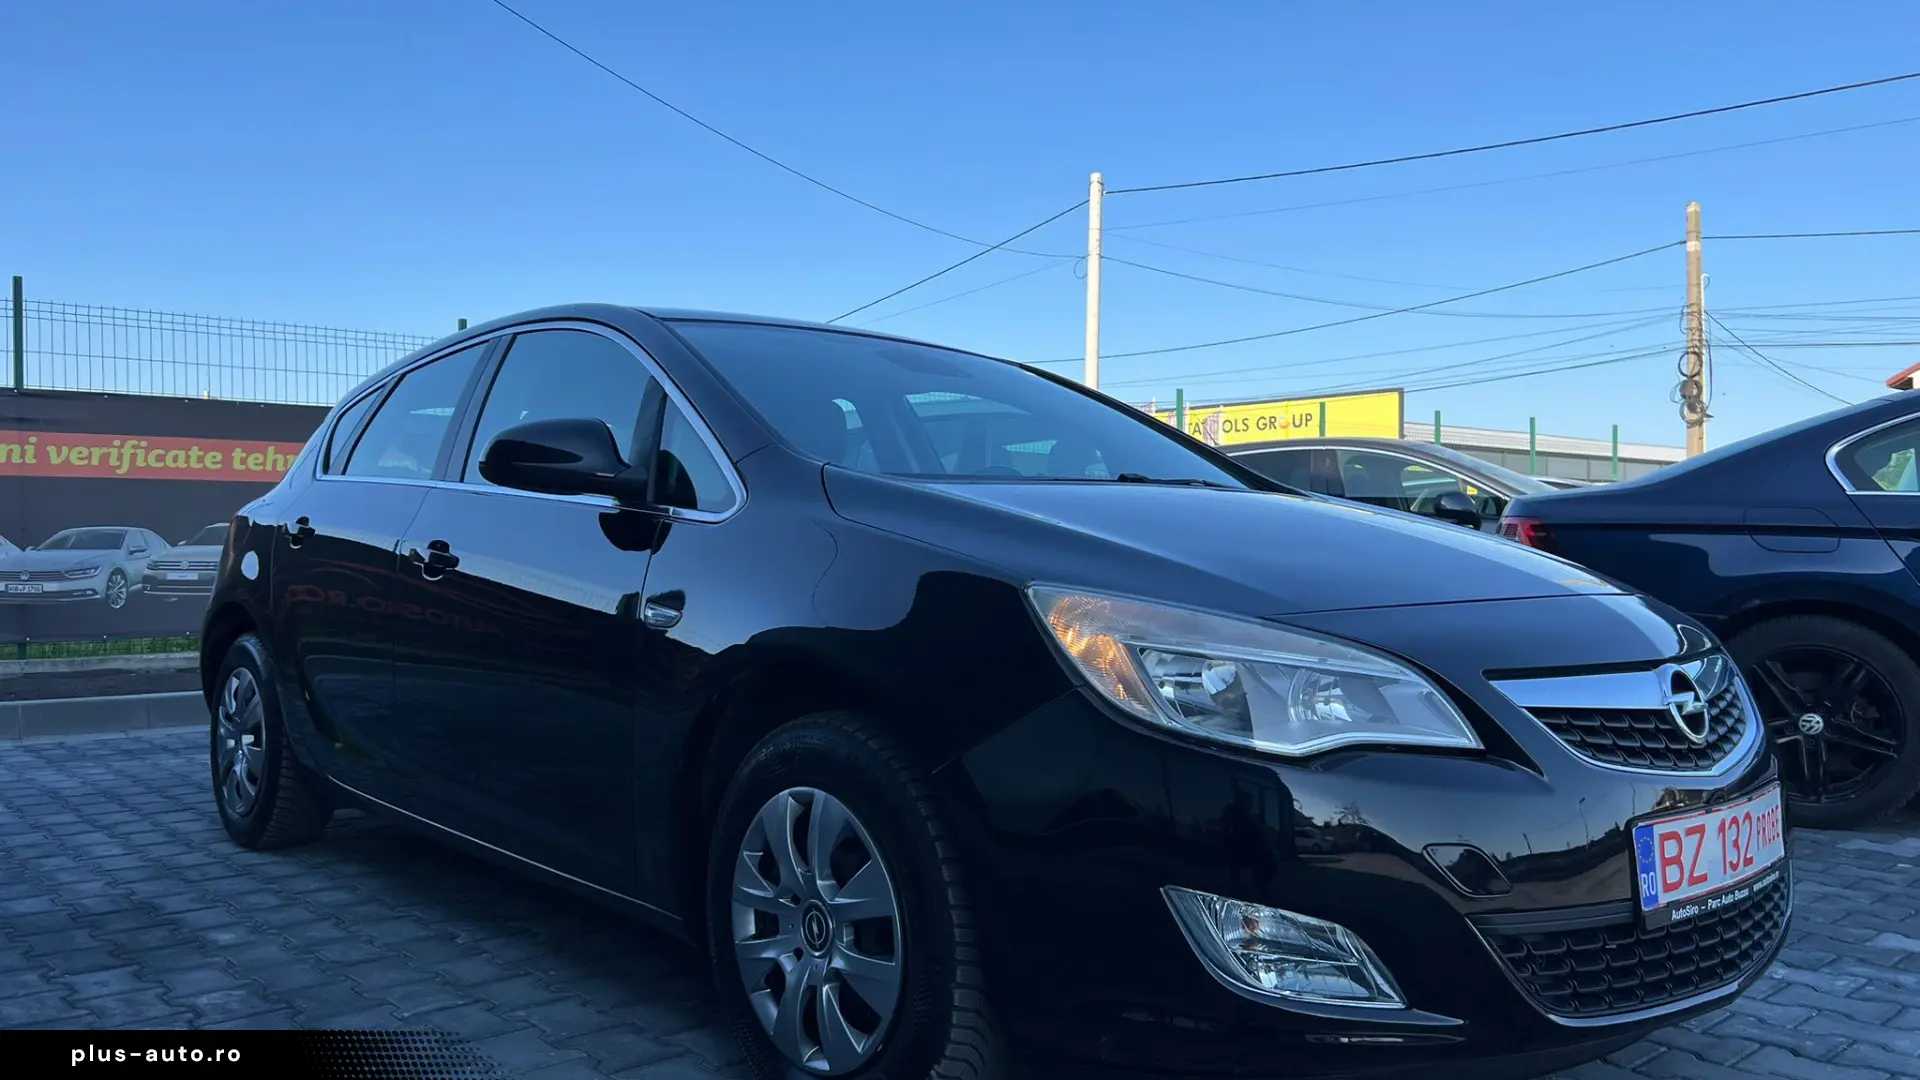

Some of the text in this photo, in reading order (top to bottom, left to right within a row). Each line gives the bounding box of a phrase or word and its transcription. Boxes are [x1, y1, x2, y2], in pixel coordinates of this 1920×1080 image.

[46, 440, 223, 474] verificate
[1658, 805, 1780, 892] BZ 132 PROBE
[1641, 871, 1656, 898] RO
[1671, 905, 1699, 921] AutoSiro
[1707, 896, 1721, 910] Parc
